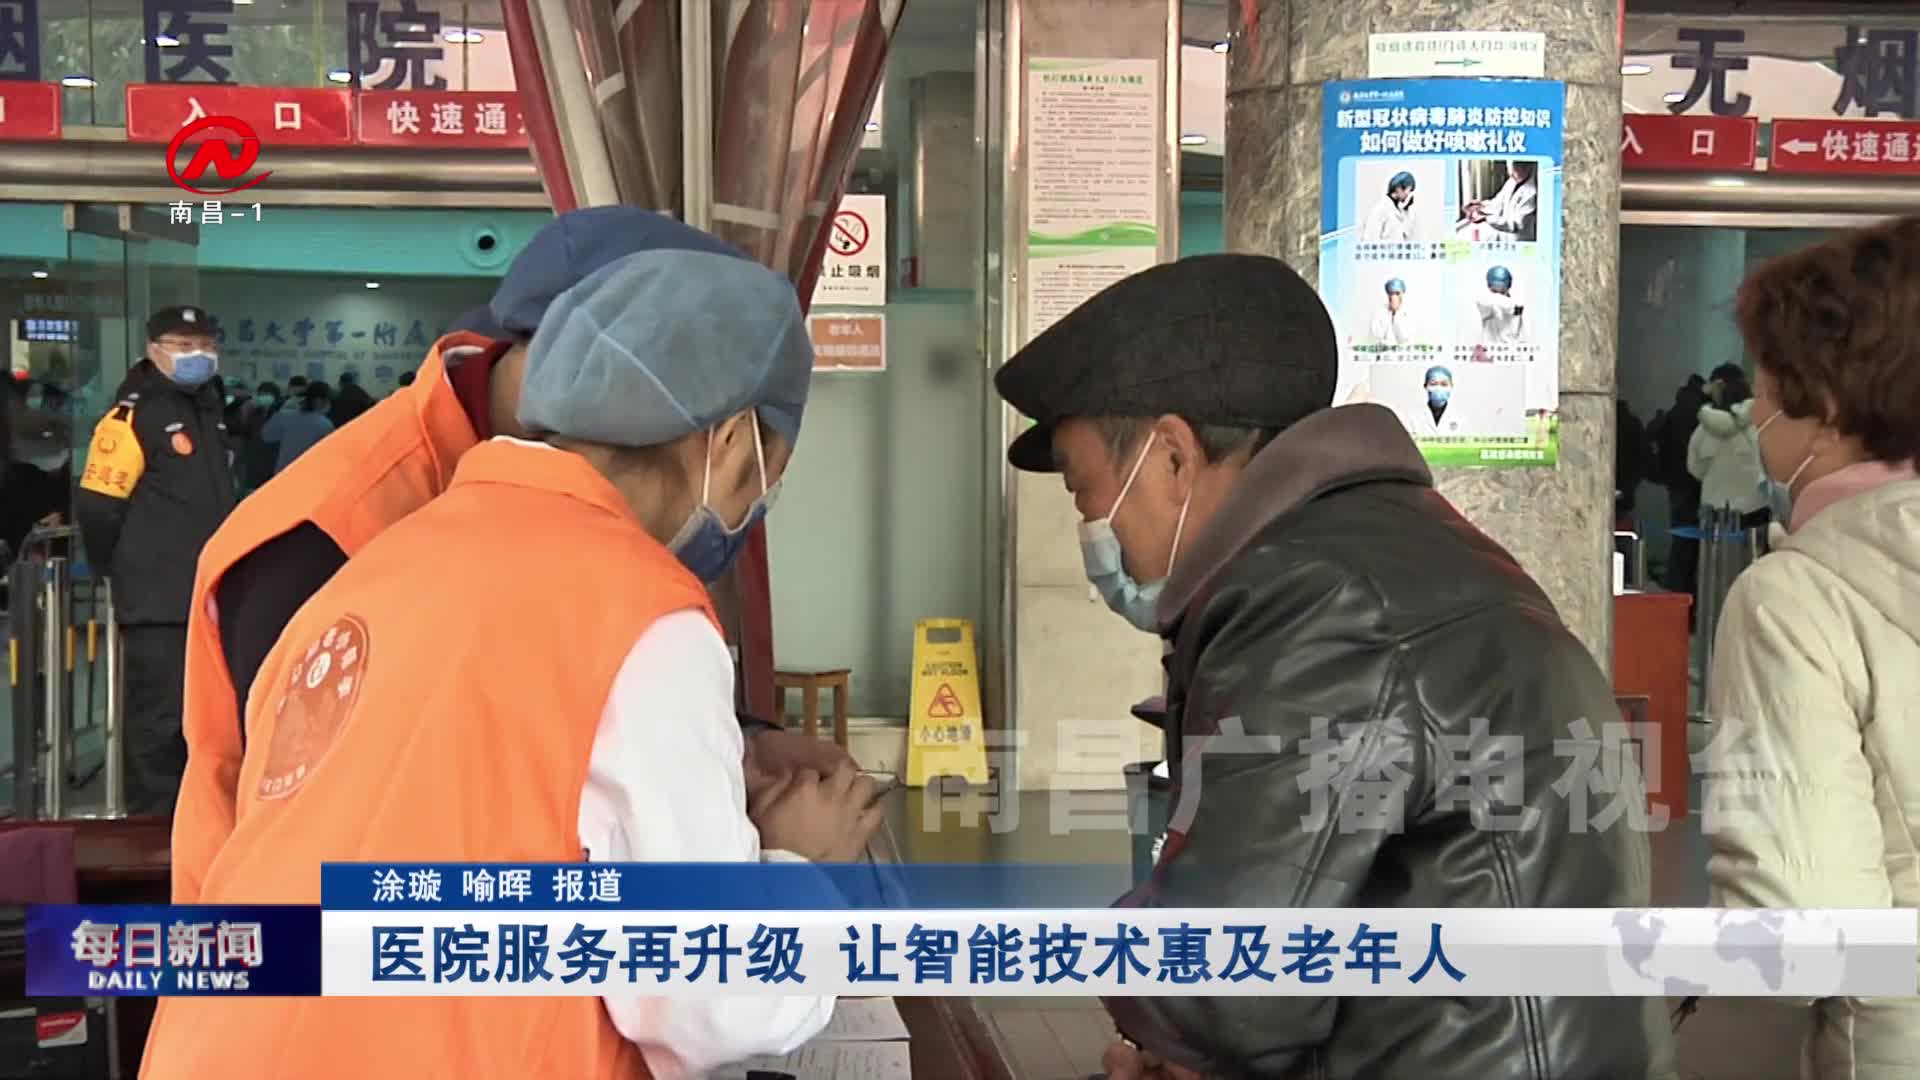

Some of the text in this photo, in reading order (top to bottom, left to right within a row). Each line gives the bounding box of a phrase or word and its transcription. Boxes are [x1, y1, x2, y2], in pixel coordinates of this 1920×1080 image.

[388, 102, 526, 133] 快速通
[1336, 106, 1552, 129] 新型冠状病毒肺炎防控知识
[1359, 129, 1527, 154] 如何做好咳嗽礼仪
[822, 264, 881, 279] 止吸烟
